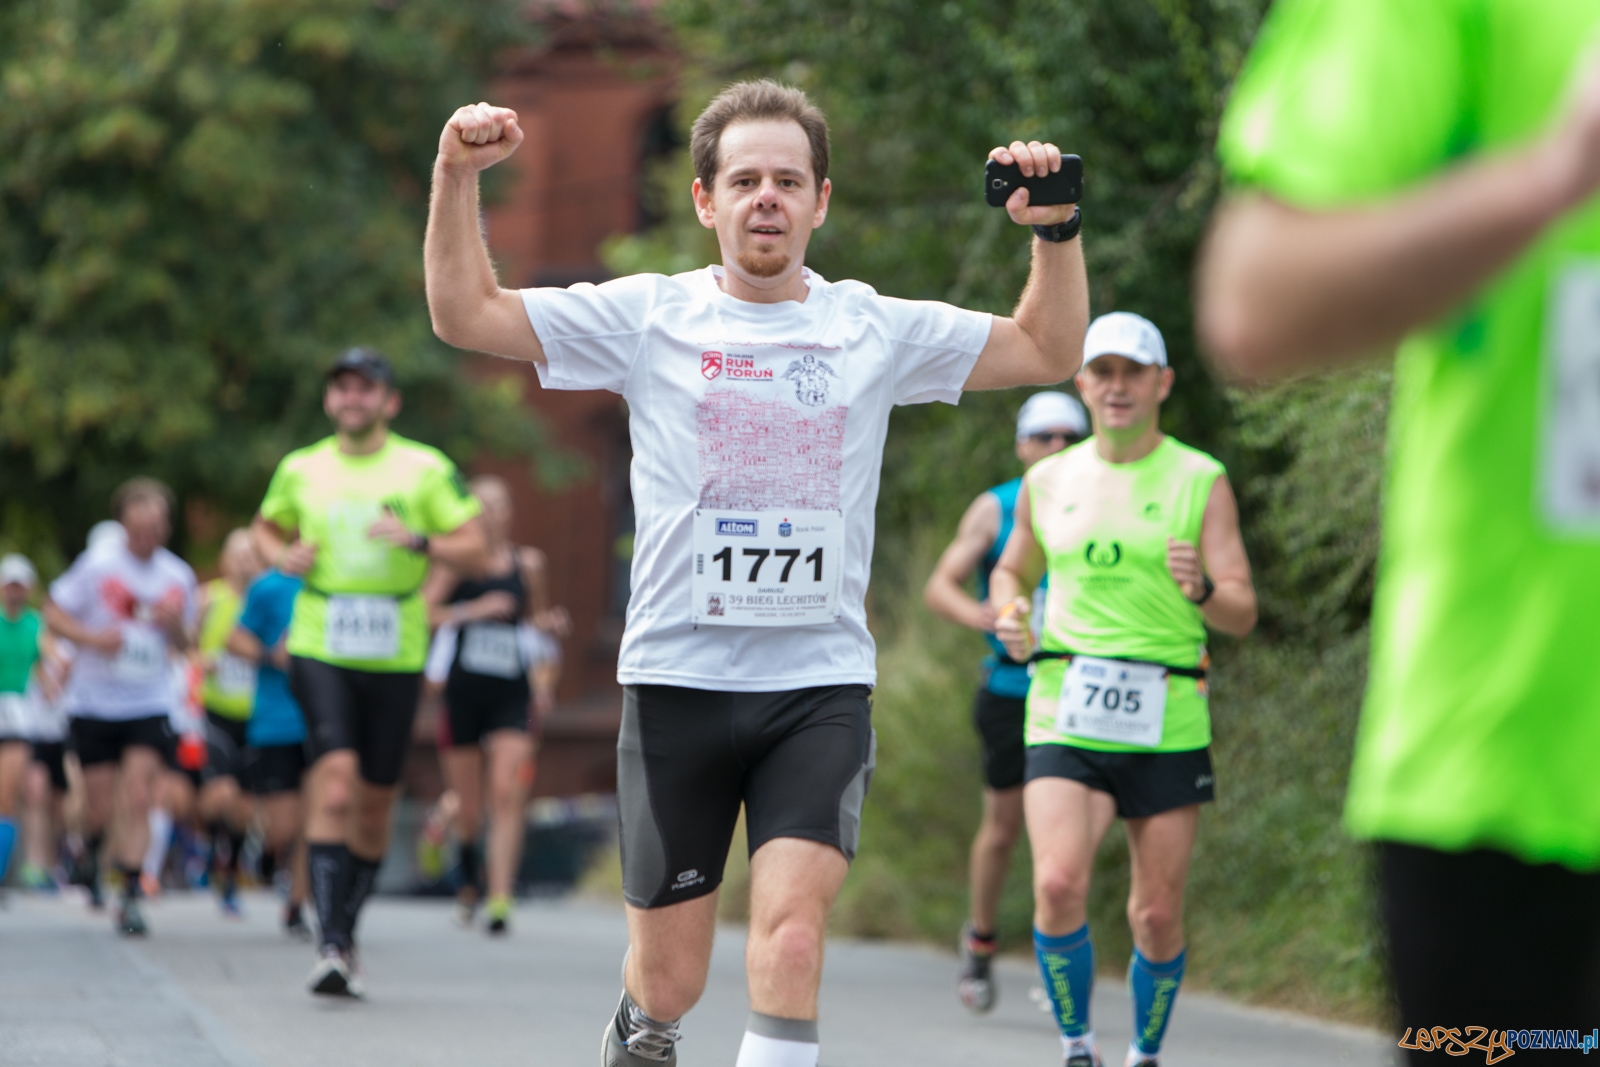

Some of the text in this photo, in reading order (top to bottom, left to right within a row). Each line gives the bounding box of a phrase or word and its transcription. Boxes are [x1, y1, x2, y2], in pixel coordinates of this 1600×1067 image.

[726, 358, 754, 368] RUN
[726, 367, 773, 377] TORUŃ
[713, 546, 823, 583] 1771
[728, 593, 827, 606] 39 BIEG LECHITÓW
[1084, 683, 1142, 713] 705
